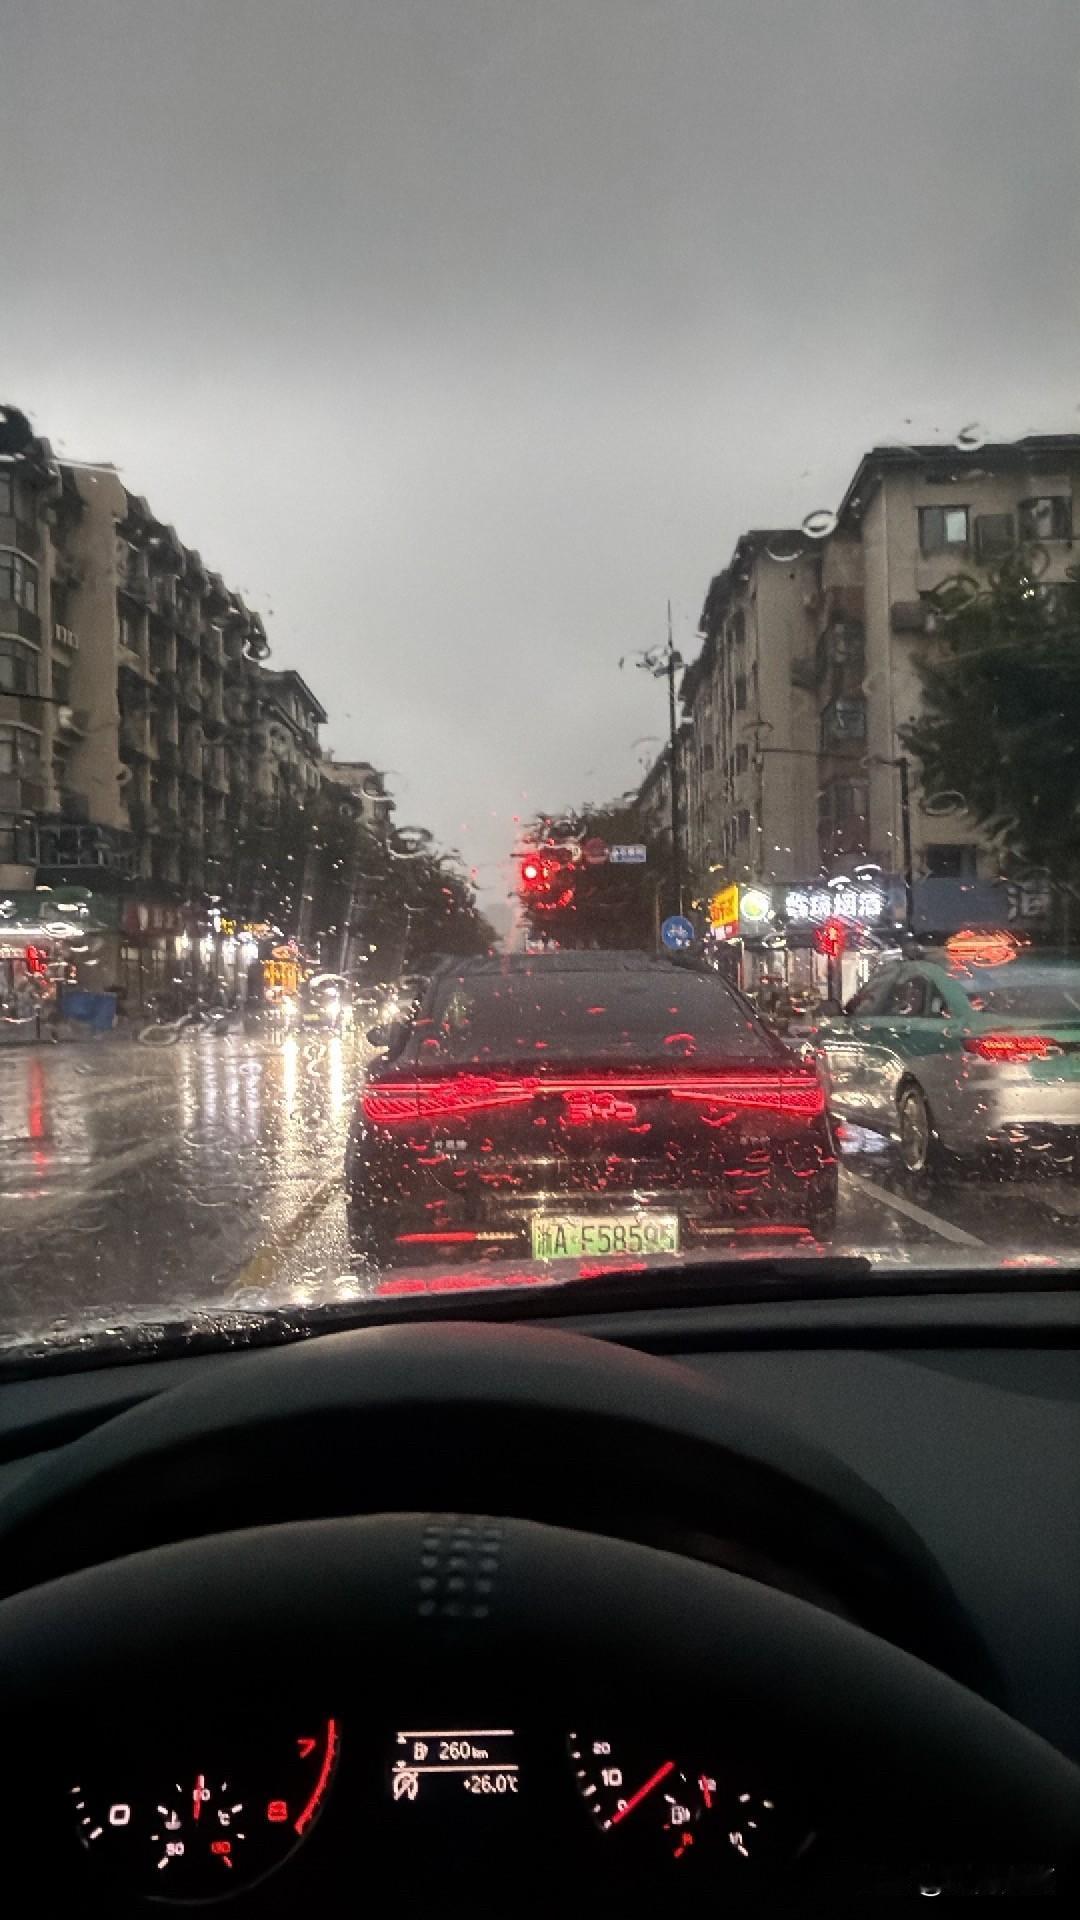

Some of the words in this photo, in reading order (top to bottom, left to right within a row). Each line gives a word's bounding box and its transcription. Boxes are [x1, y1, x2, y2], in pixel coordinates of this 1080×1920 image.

[298, 1739, 316, 1758] 7
[601, 1768, 623, 1787] 10
[110, 1804, 131, 1826] 0
